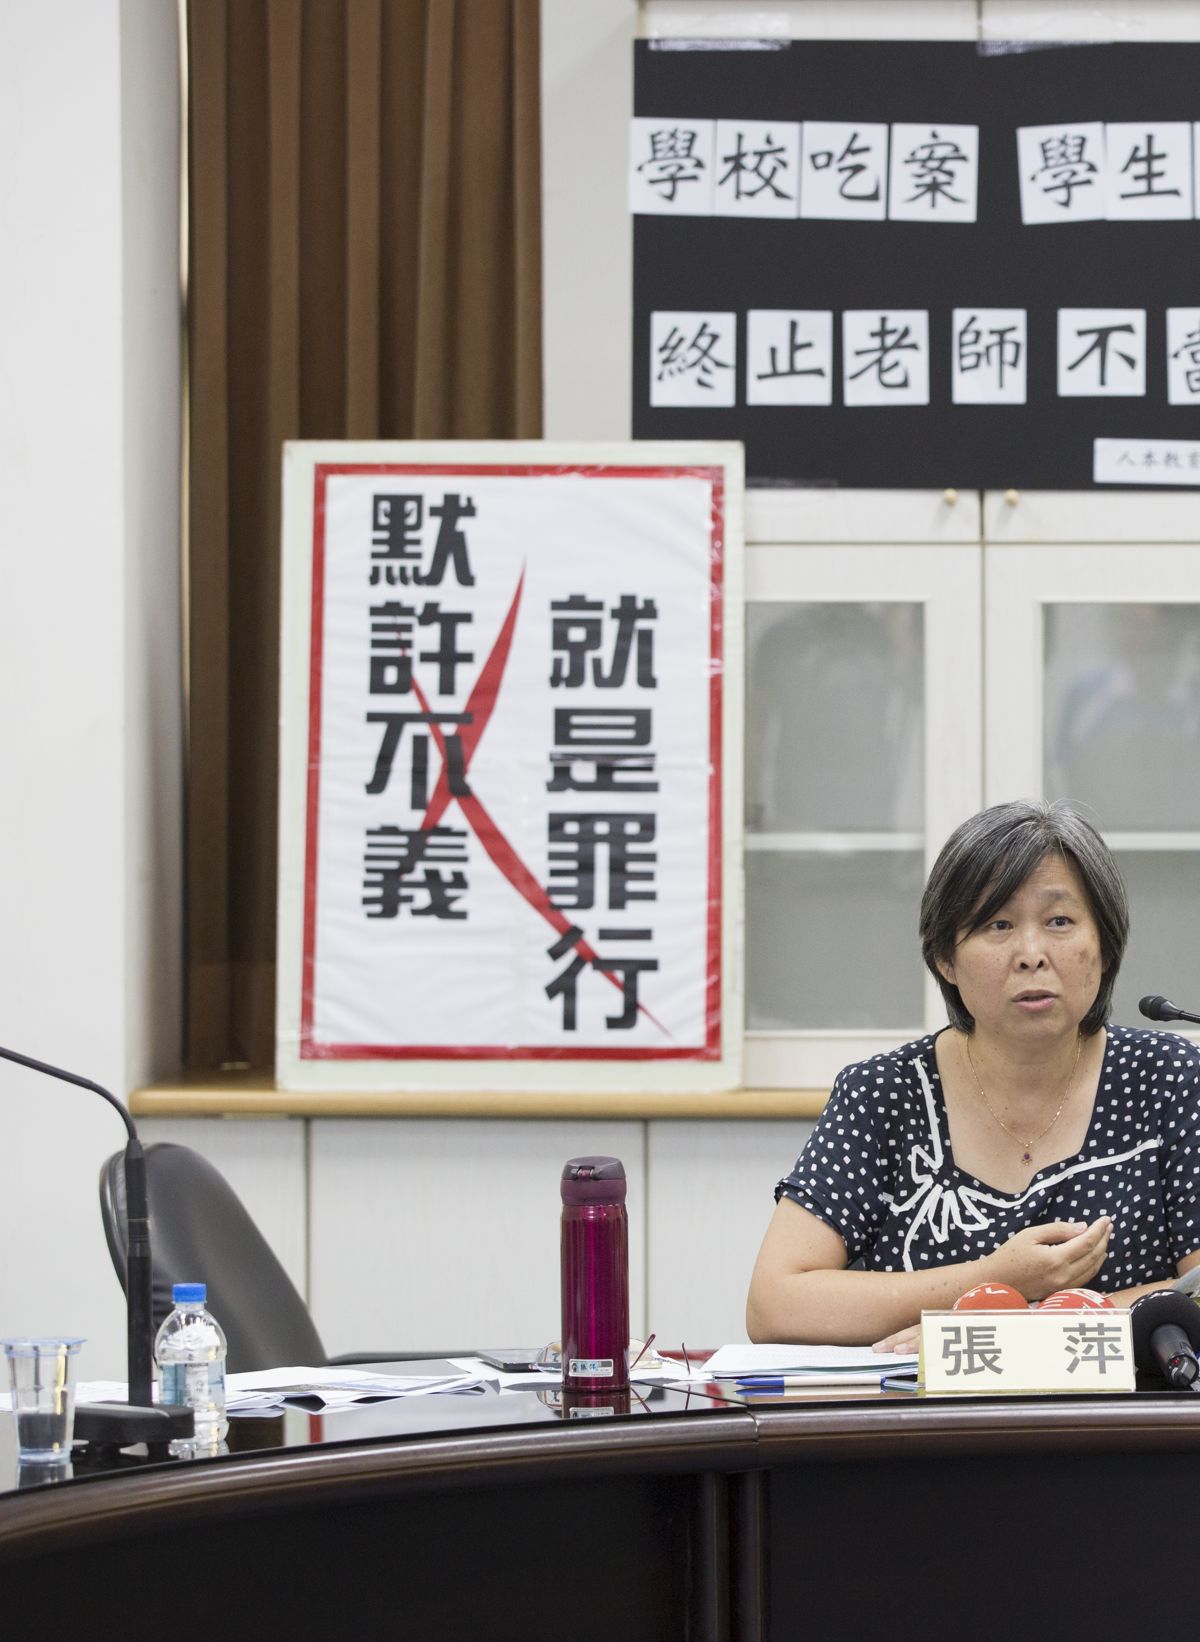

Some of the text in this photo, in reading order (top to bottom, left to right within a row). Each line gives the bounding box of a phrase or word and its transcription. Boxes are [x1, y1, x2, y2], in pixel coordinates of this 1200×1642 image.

[636, 127, 970, 209] 學校吃案
[361, 493, 477, 921] 默許不義
[545, 594, 659, 1031] 就是罪行
